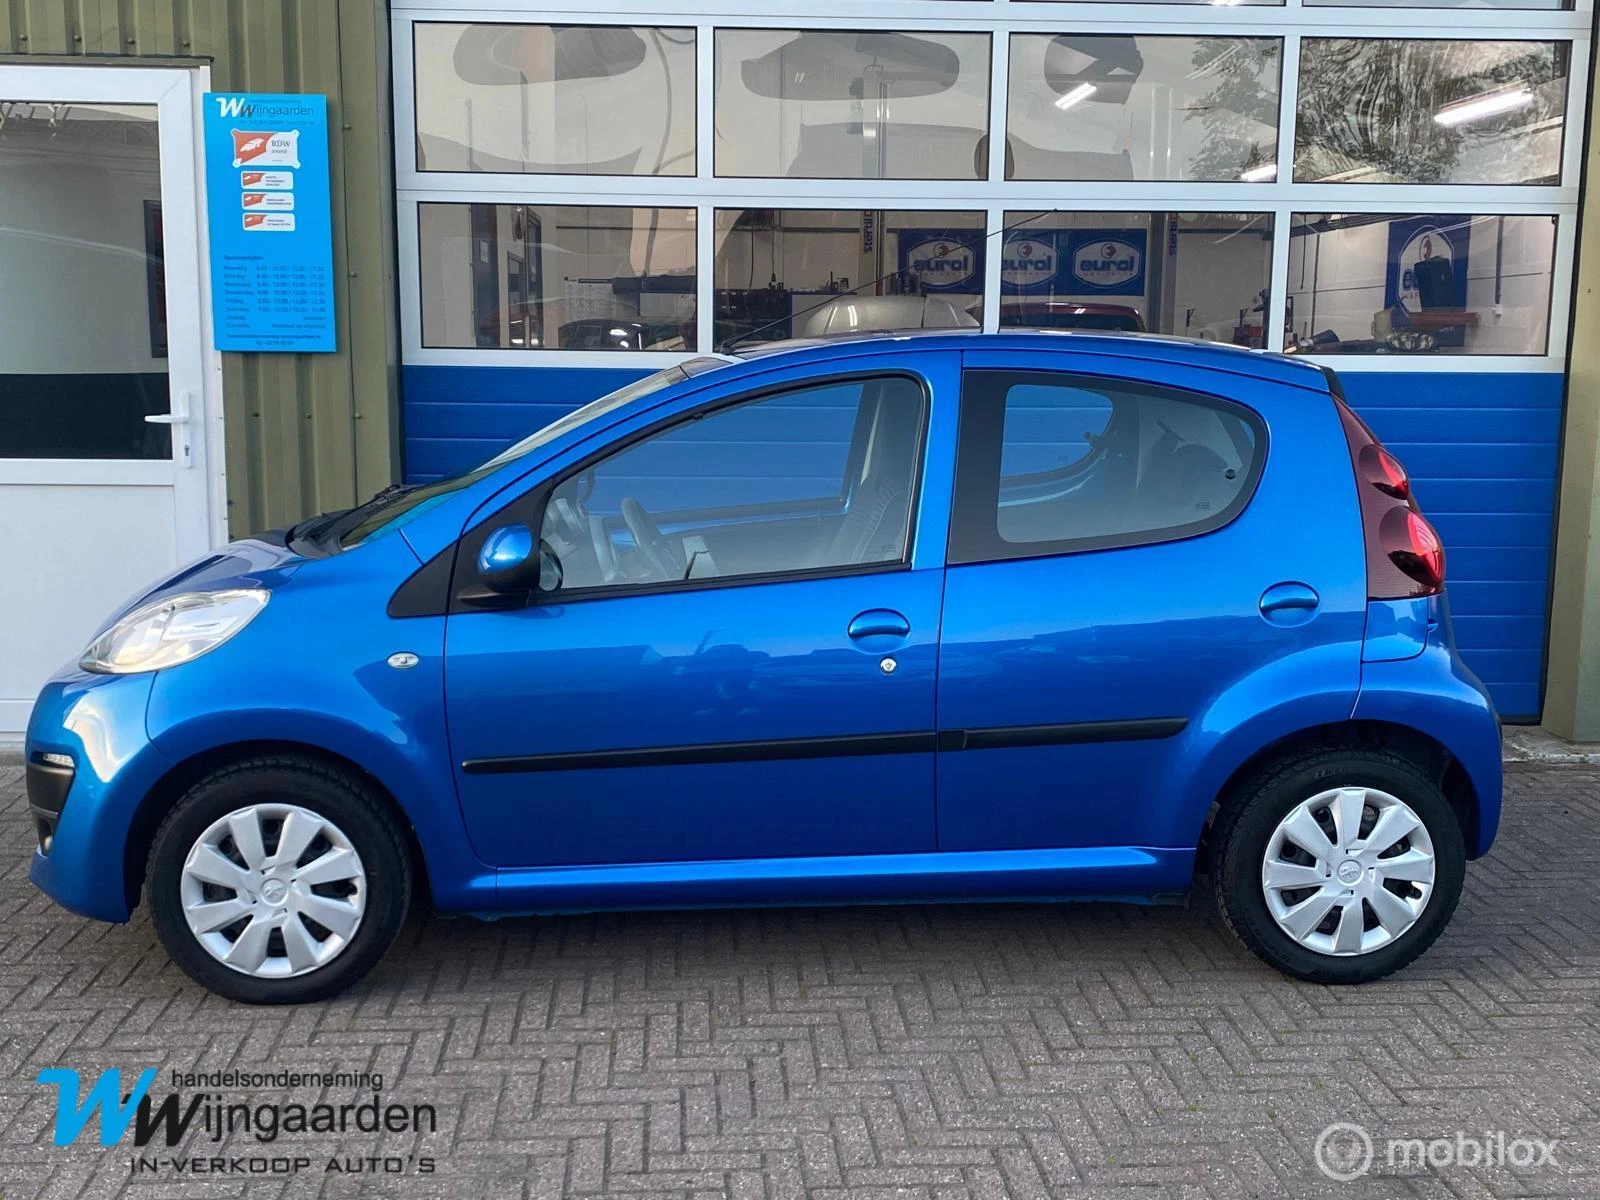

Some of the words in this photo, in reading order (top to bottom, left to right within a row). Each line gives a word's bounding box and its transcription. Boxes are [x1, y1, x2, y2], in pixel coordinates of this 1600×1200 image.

[271, 139, 291, 147] RDW
[914, 255, 968, 271] eurol
[1080, 255, 1135, 271] eurol
